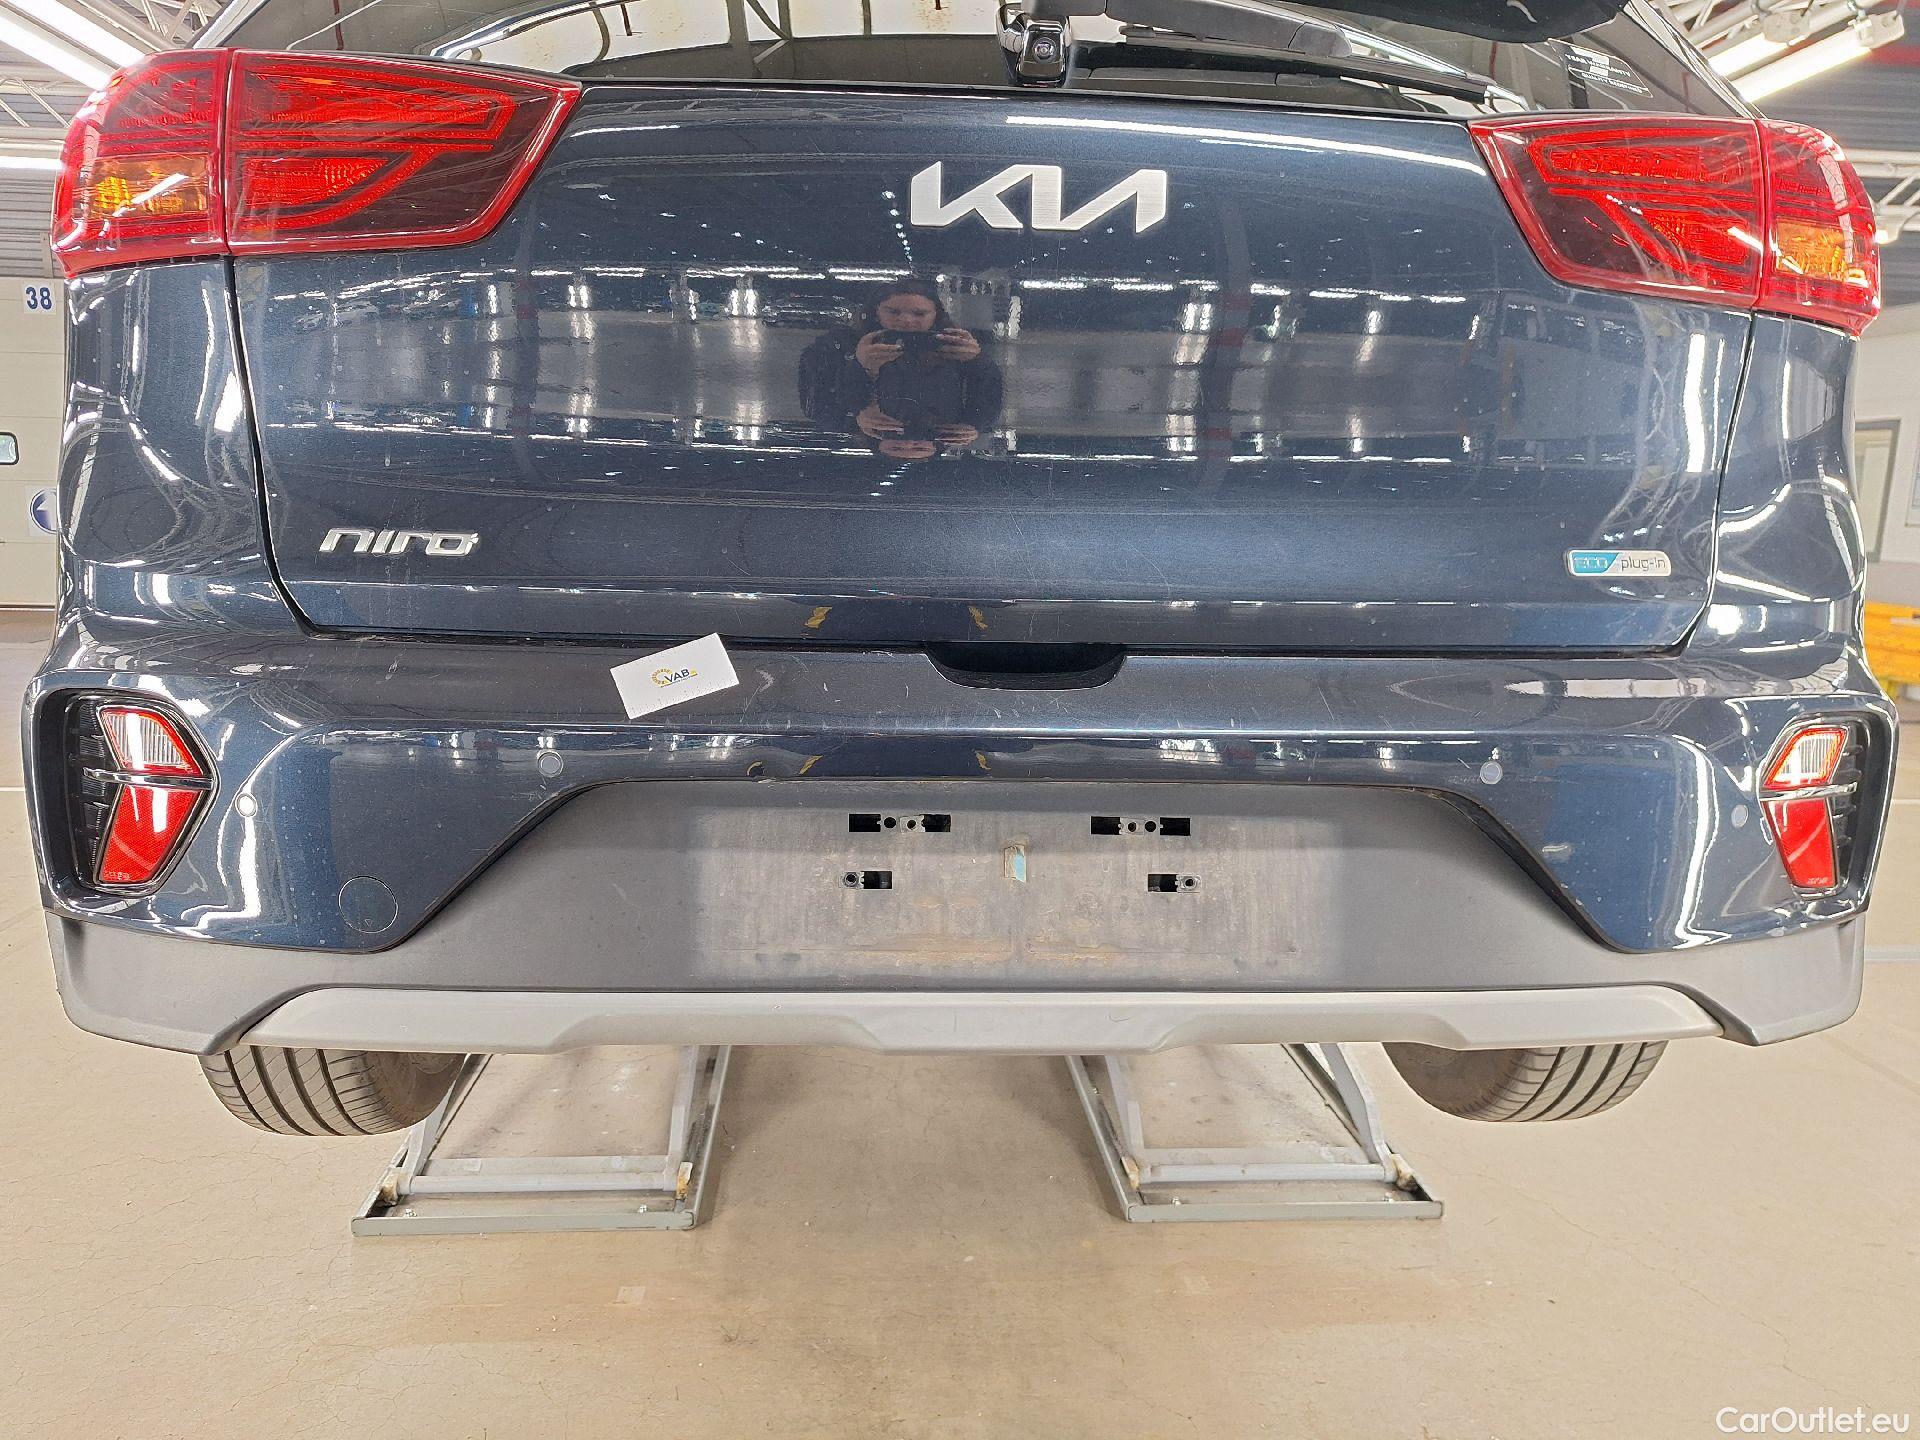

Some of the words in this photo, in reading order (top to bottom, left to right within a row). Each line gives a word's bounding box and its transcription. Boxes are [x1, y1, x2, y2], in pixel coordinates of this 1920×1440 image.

[911, 160, 1167, 233] KIA
[25, 286, 52, 310] 38
[1620, 556, 1666, 571] plug-in
[664, 668, 690, 683] VAB
